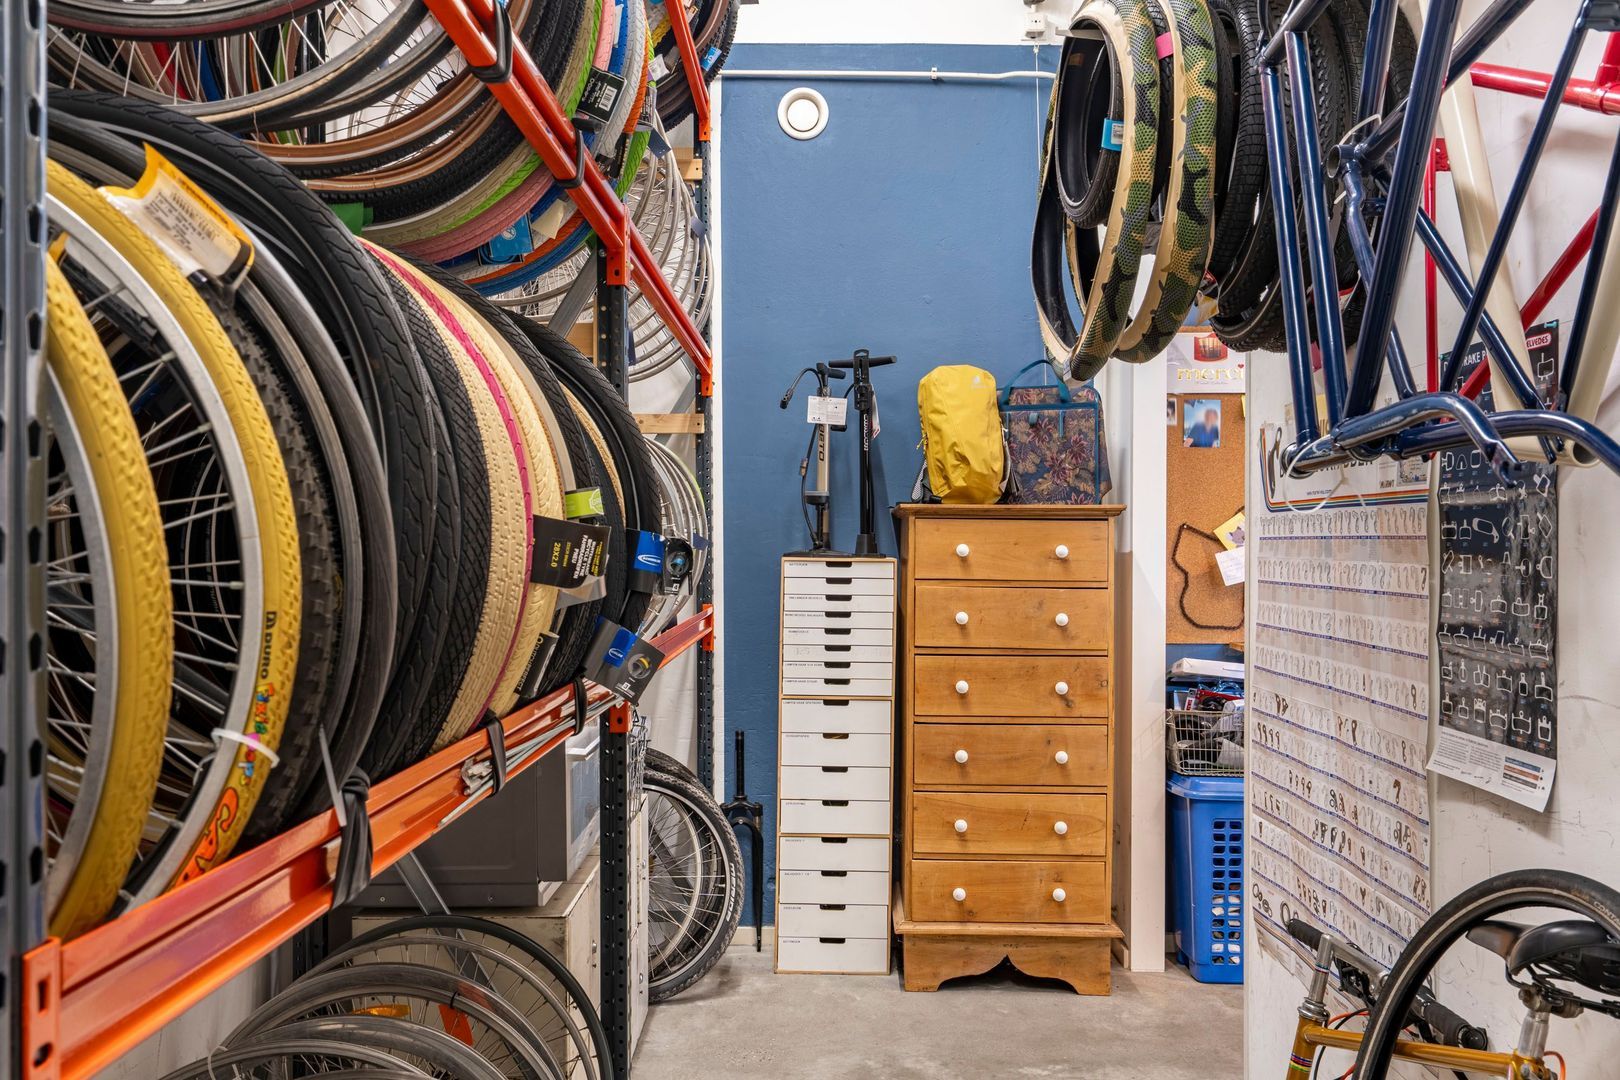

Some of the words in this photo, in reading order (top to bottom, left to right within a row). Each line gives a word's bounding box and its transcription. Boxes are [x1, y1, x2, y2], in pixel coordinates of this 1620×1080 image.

[1462, 351, 1481, 367] RAKE
[1177, 363, 1243, 381] merci
[550, 542, 561, 568] 28X2.0
[571, 548, 580, 564] PNEU
[260, 635, 274, 679] DURO
